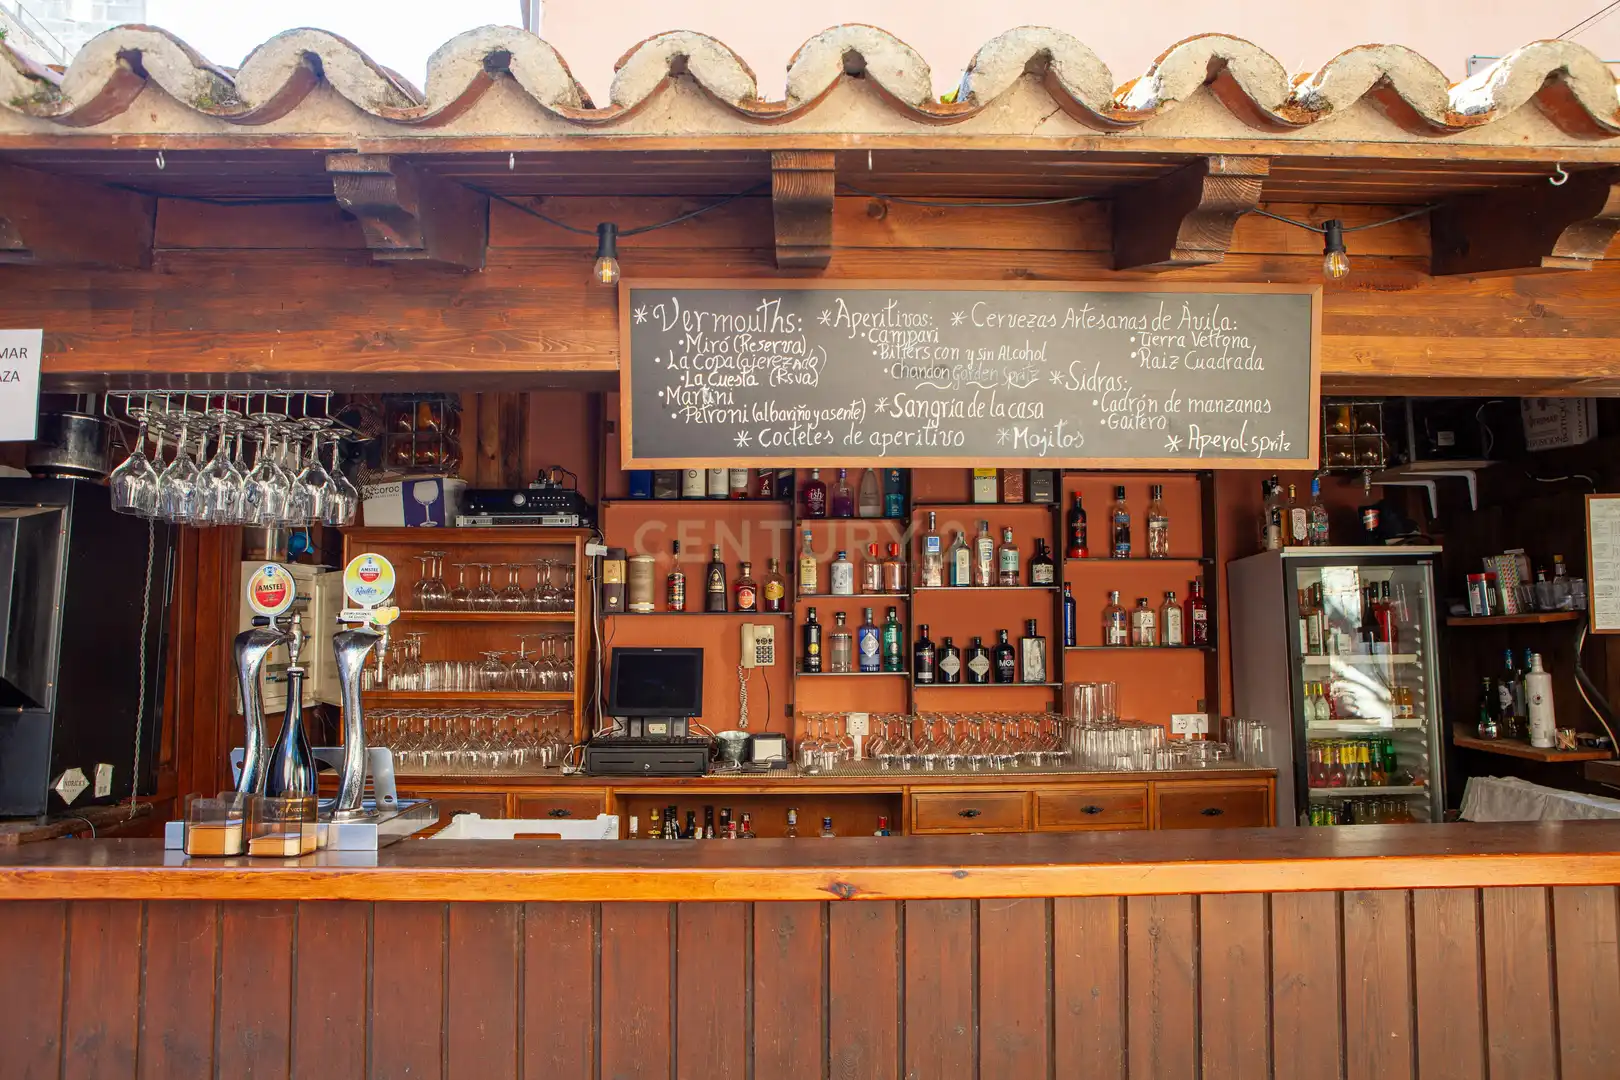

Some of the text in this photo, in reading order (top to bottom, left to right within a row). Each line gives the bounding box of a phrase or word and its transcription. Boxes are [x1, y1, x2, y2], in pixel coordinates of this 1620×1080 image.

[652, 296, 803, 333] Vermouths:
[834, 298, 934, 338] Aperitivos:
[971, 301, 1057, 328] Cervezas
[1061, 303, 1148, 330] Artesanas
[1151, 301, 1173, 331] de
[685, 332, 806, 356] Miró (Reserva)
[868, 327, 939, 347] Campari
[1137, 331, 1186, 347] Tierra
[667, 350, 690, 370] La
[693, 354, 735, 373] Copa
[878, 342, 931, 360] Bitters
[934, 346, 960, 361] con
[966, 346, 975, 369] y
[976, 346, 994, 361] sin
[1184, 346, 1265, 371] Cuadrada
[0, 371, 20, 383] ZA
[684, 371, 703, 388] La
[706, 369, 759, 387] Cuesta
[890, 358, 950, 381] Chandon
[1065, 360, 1130, 392] Sidras:
[666, 385, 735, 405] Martini
[1164, 389, 1181, 413] de
[1188, 397, 1272, 413] manzanas
[679, 404, 749, 424] Petroni
[889, 390, 1044, 428] Sangría de la casa
[758, 419, 965, 457] Cocteles de aperitivo
[1013, 419, 1084, 456] Mojitos
[258, 583, 284, 591] AMSTEL
